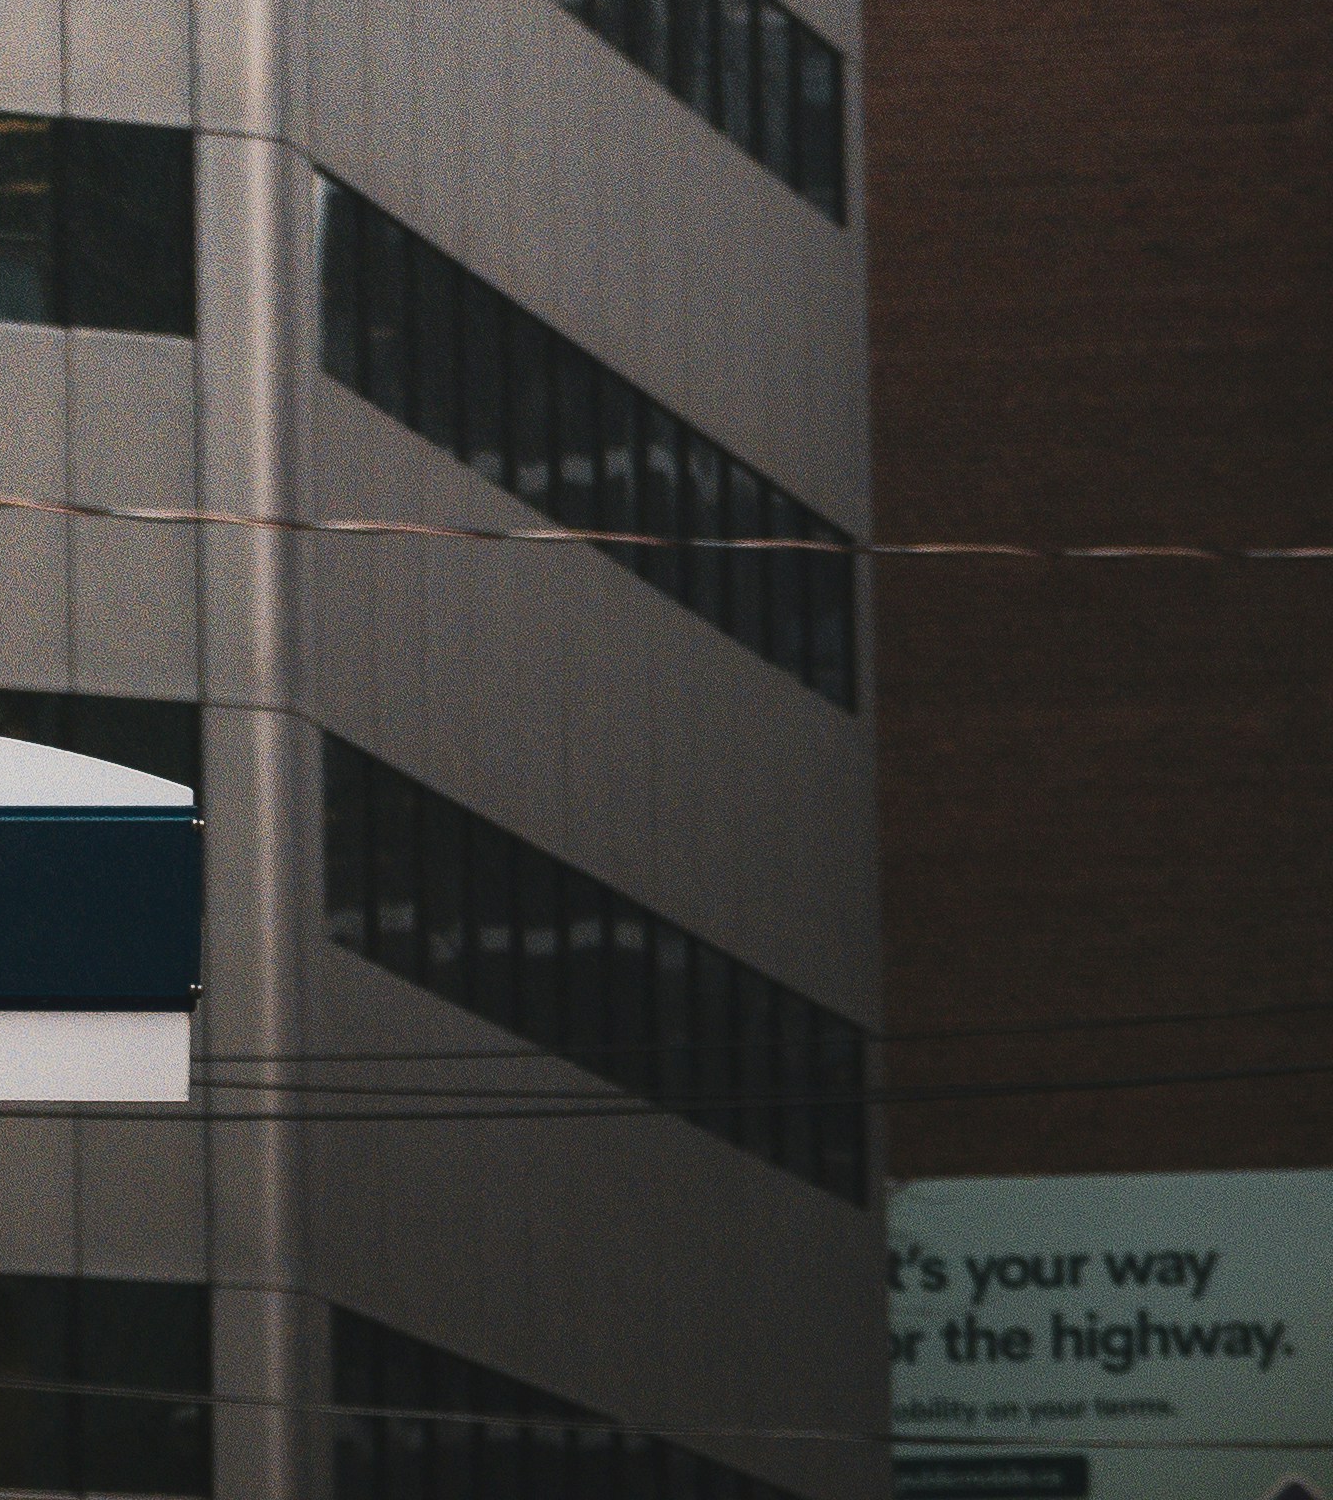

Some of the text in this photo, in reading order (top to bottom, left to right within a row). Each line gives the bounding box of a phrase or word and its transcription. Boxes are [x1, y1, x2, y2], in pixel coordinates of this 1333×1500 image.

[965, 1251, 1090, 1304] your
[1104, 1250, 1218, 1300] way
[941, 1314, 1034, 1363] the
[1051, 1309, 1294, 1376] highway.
